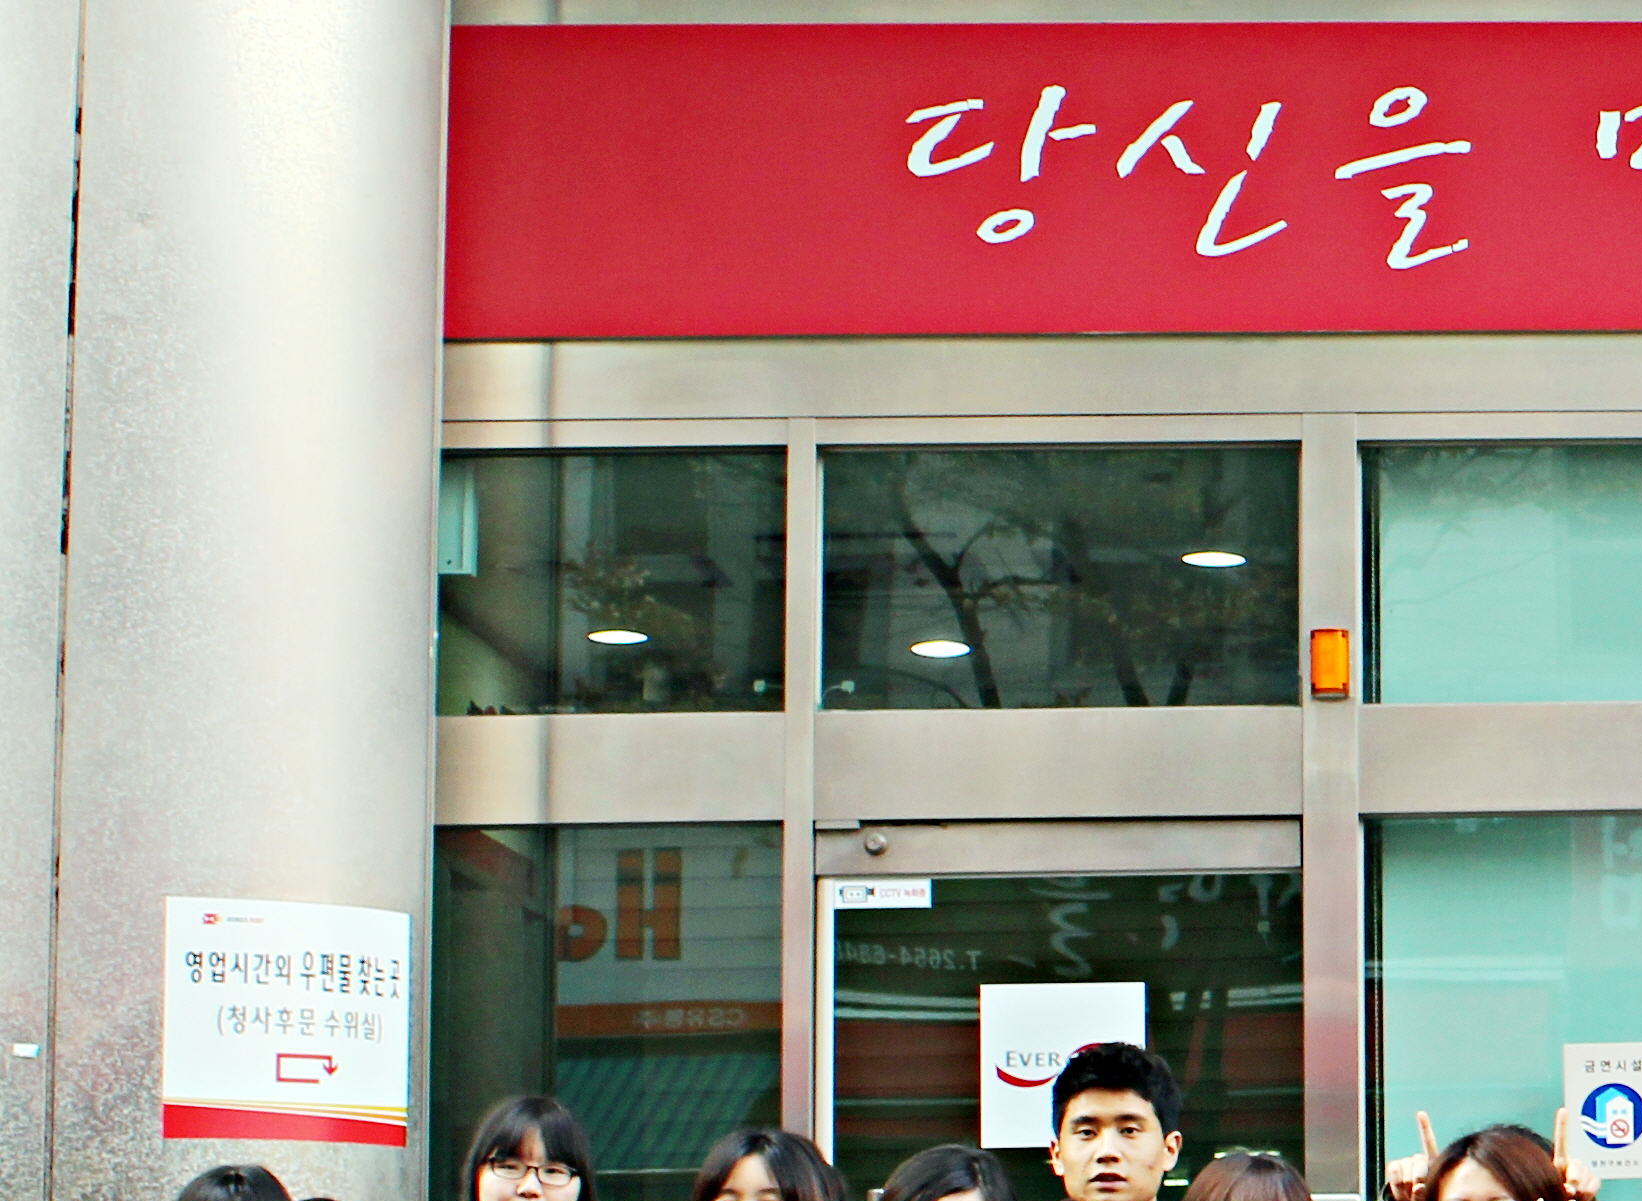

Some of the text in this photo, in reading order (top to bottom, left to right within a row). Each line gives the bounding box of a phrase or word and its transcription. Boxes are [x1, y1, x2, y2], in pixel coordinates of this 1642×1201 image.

[905, 85, 1471, 269] 당신을
[185, 951, 292, 986] 영업시간외
[216, 1004, 383, 1043] (청사후문 수위실)
[1005, 1050, 1062, 1068] EVER
[1585, 1059, 1642, 1073] 금연시설
